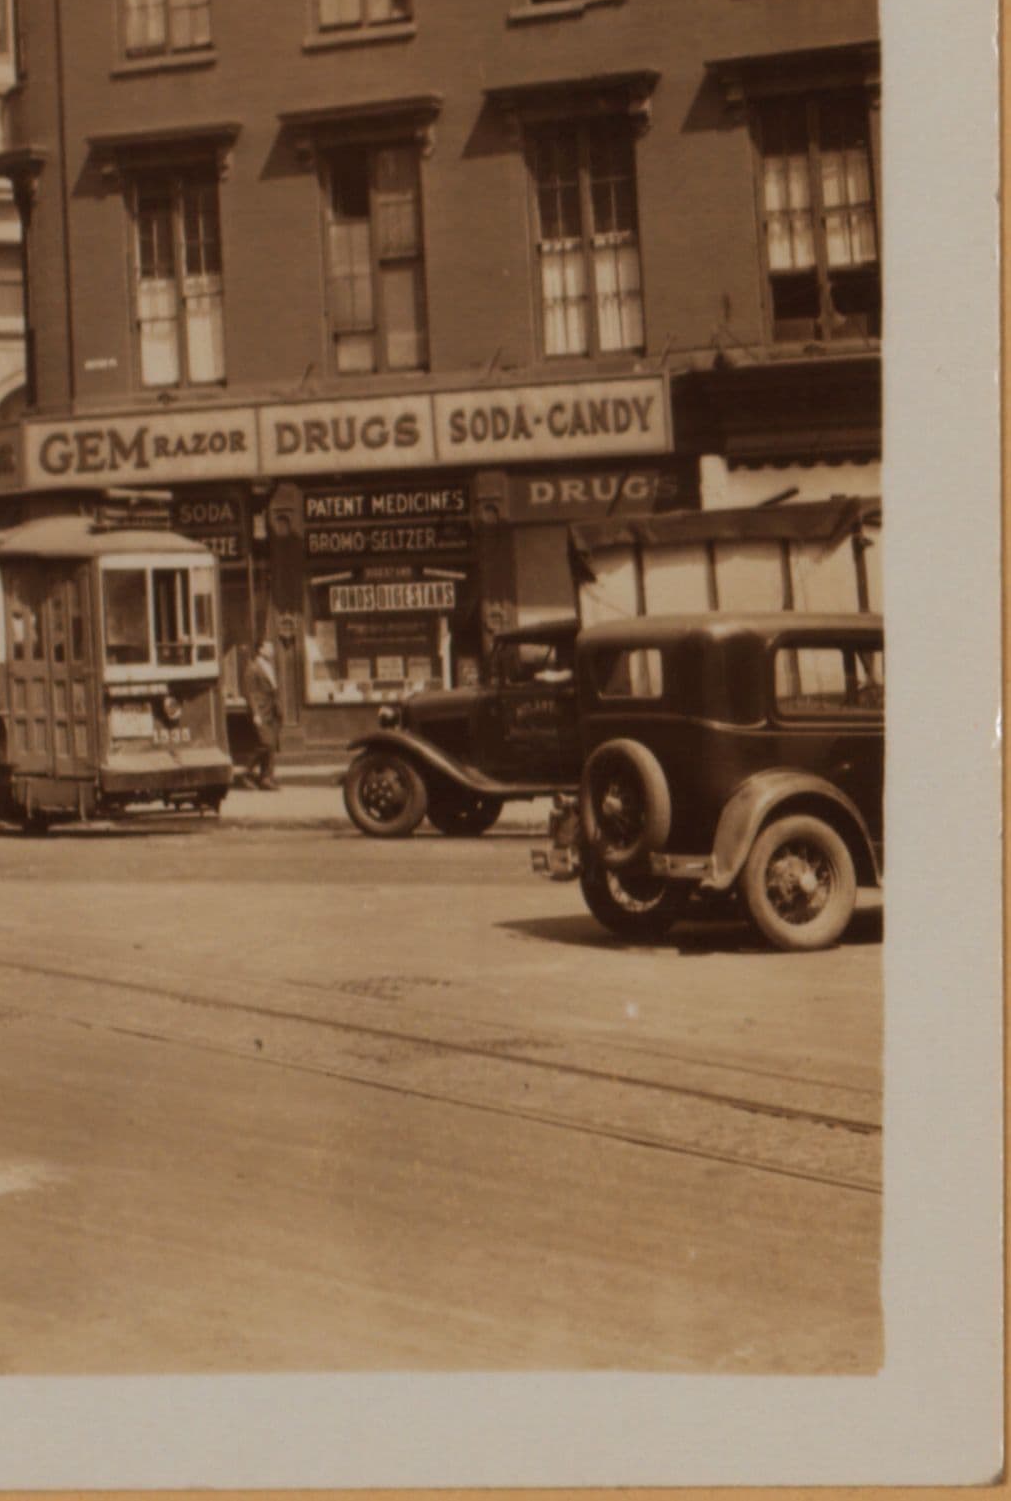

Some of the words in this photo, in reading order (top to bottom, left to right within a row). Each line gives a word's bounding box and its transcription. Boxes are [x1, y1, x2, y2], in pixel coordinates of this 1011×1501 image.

[38, 426, 150, 475] GEM
[153, 430, 247, 458] RAZOR
[274, 412, 420, 456] DRUGS
[180, 500, 234, 524] SODA
[306, 495, 365, 518] PATENT
[371, 490, 465, 515] MEDICINES
